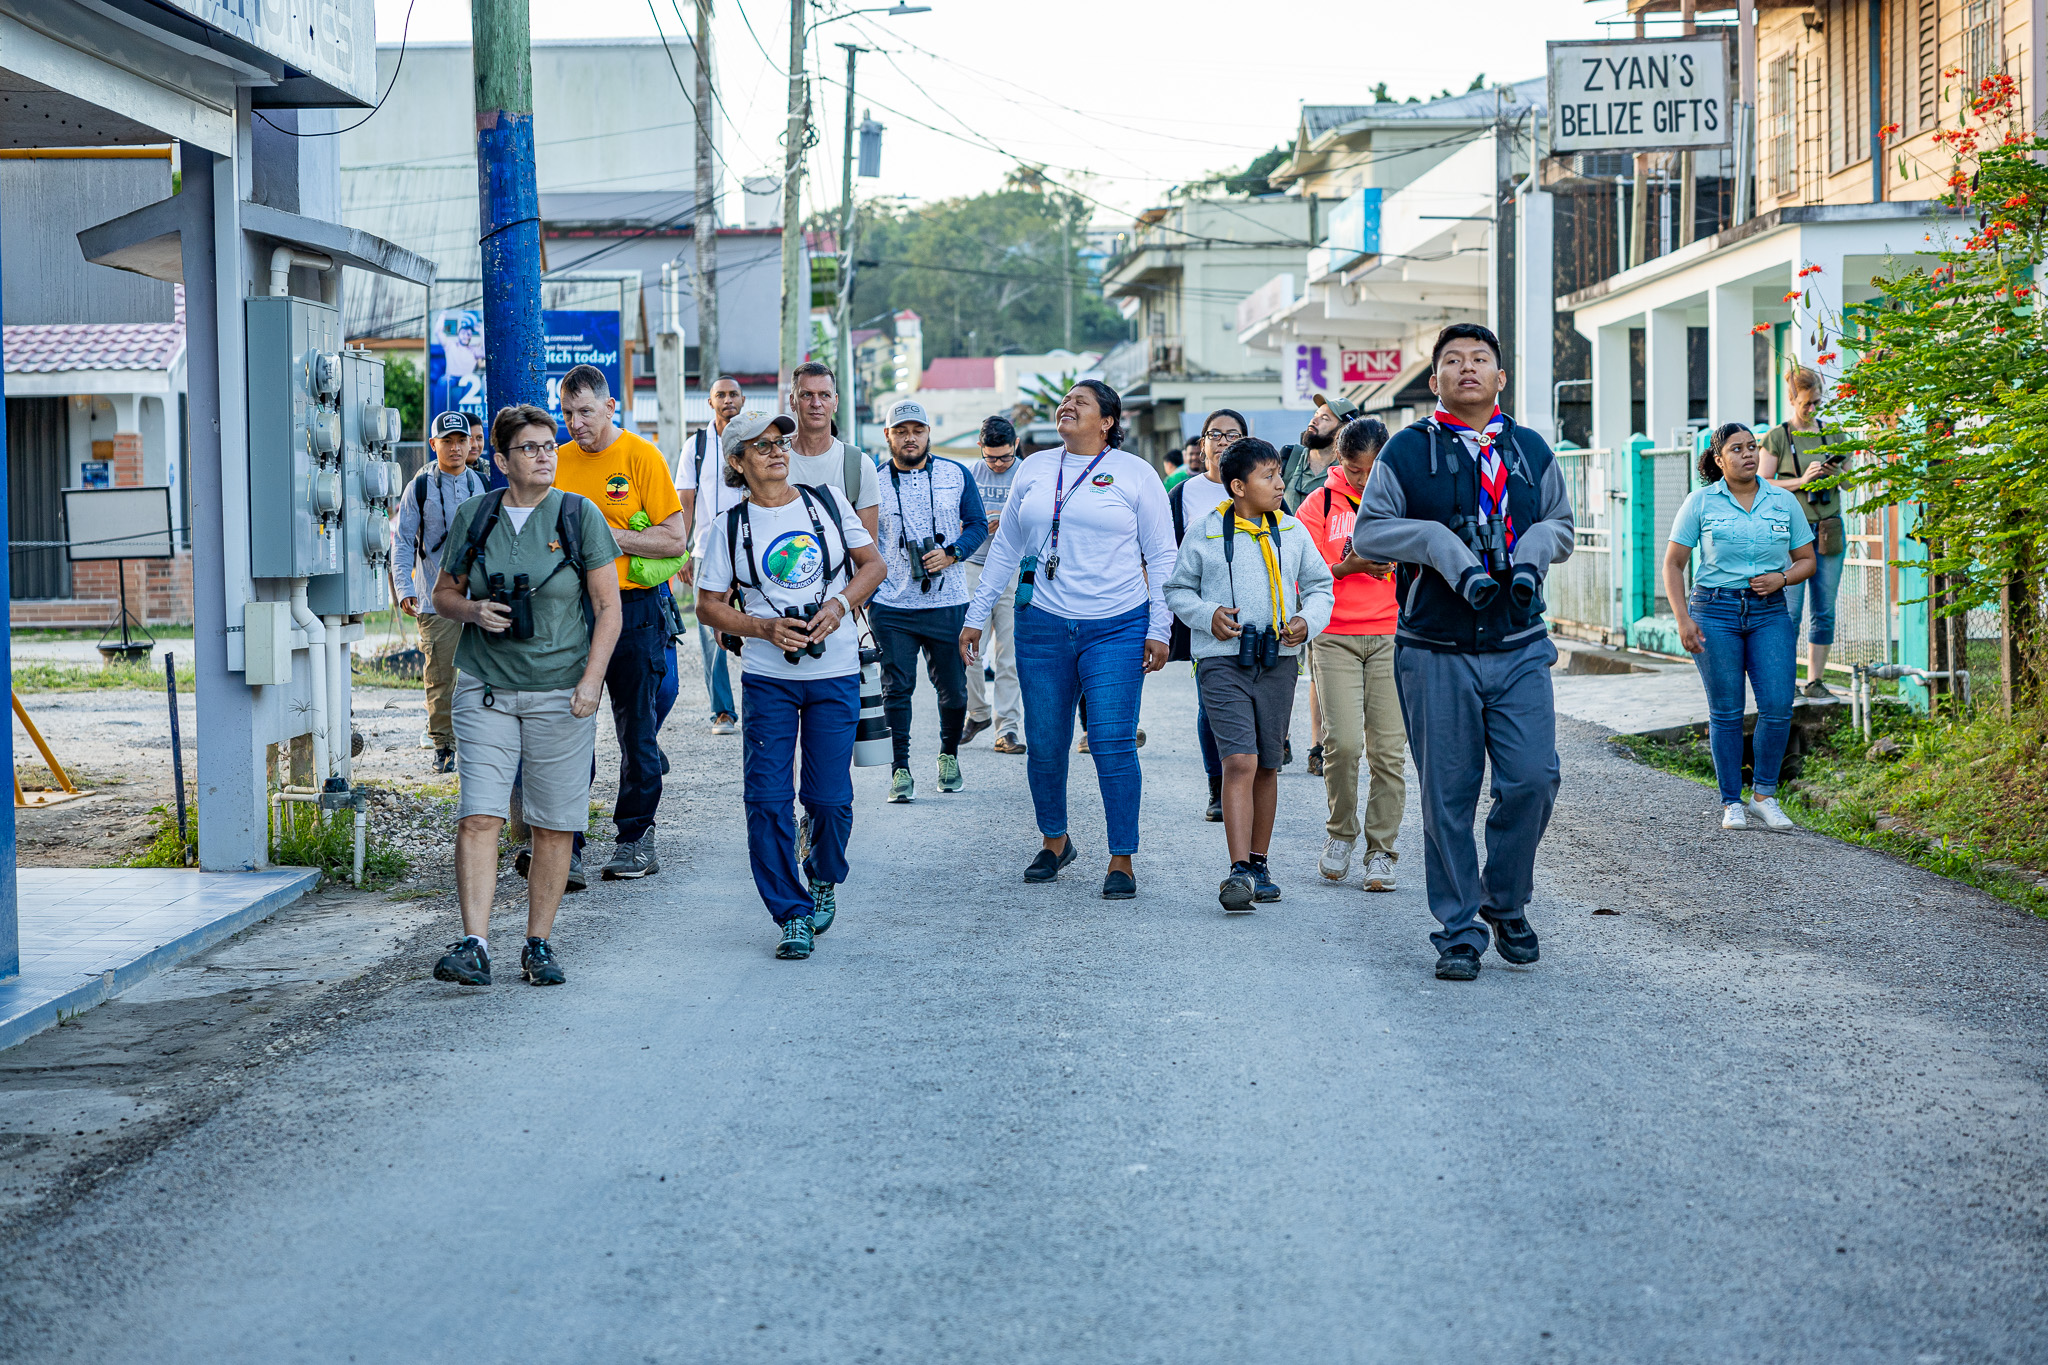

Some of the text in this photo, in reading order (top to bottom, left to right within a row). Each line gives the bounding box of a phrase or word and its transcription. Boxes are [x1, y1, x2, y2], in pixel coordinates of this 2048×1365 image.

[1582, 53, 1694, 91] ZYAN'S
[1561, 98, 1718, 137] BELIZE GIFTS
[545, 349, 617, 366] itch today!
[1343, 351, 1398, 372] PINK
[895, 404, 920, 415] PFG
